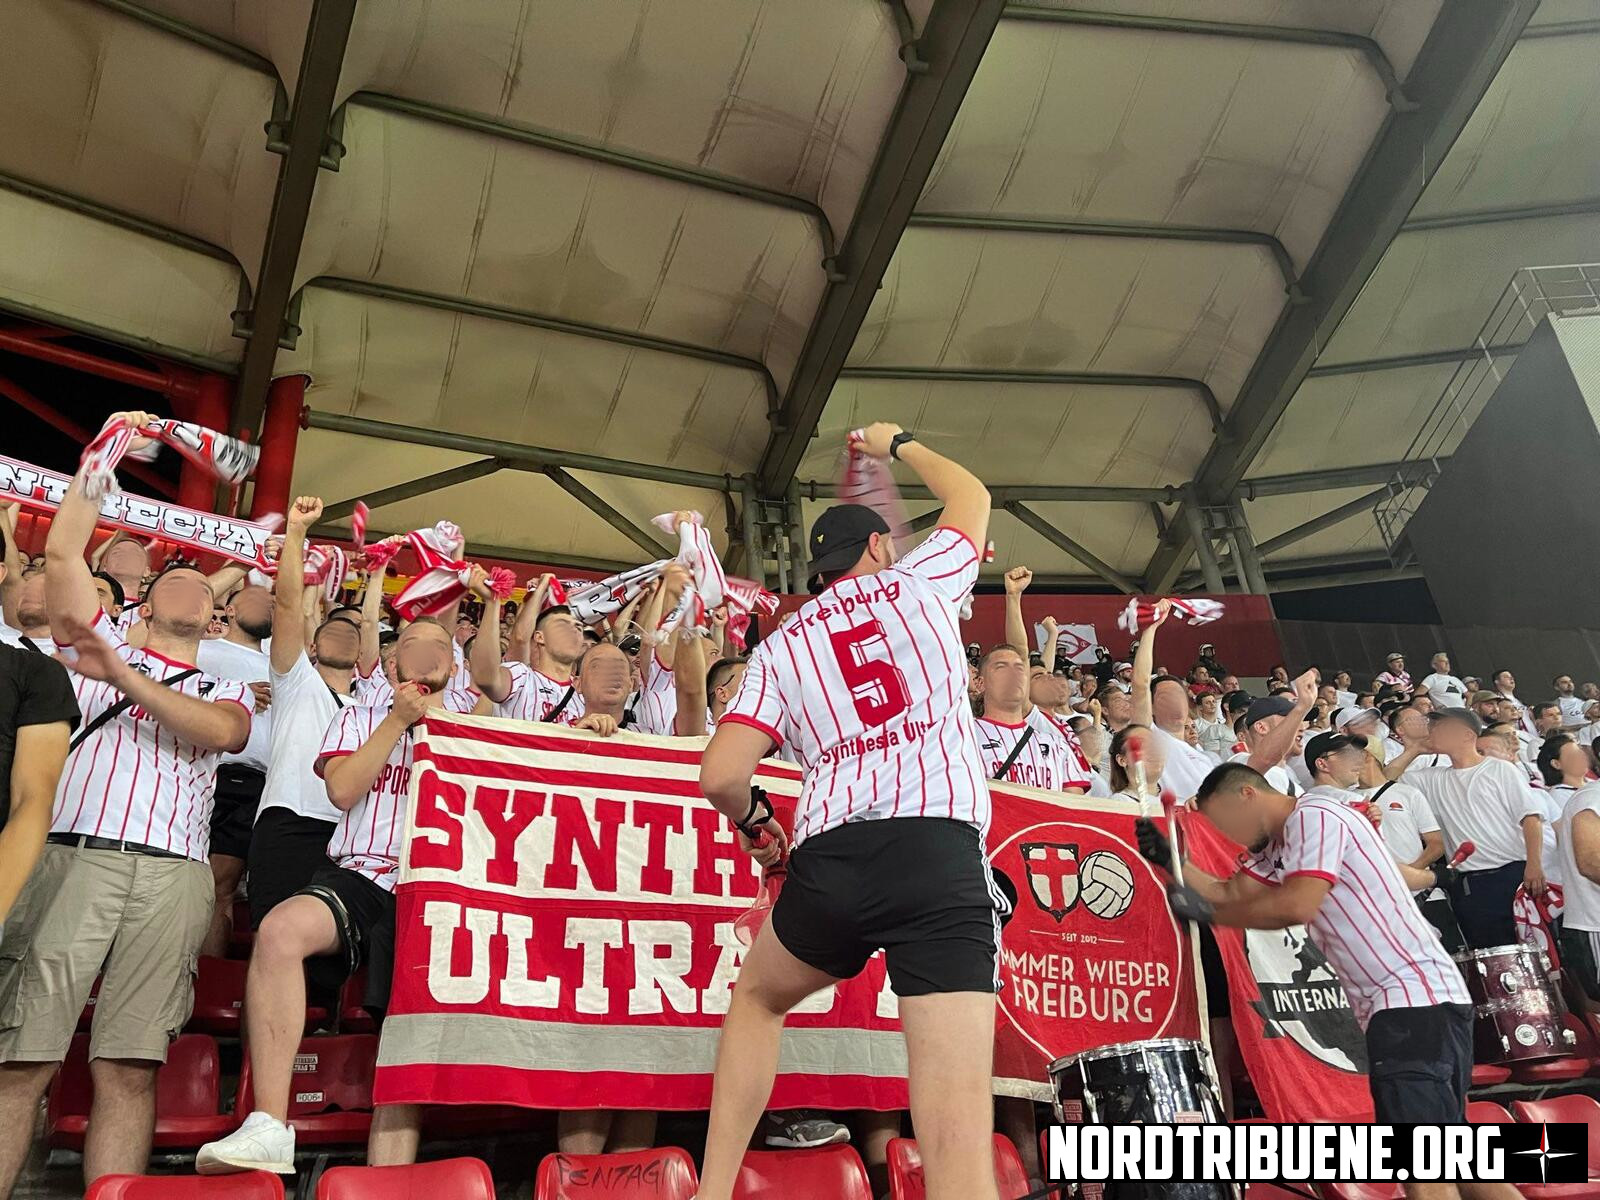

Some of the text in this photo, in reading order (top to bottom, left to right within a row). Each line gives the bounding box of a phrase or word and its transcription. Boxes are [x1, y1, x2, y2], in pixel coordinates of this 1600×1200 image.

[829, 619, 913, 727] 5
[423, 901, 836, 1015] ULTRA
[1061, 932, 1098, 944] SEIT 2012
[1084, 958, 1170, 987] WIEDER
[1011, 973, 1153, 1024] FREIBURG
